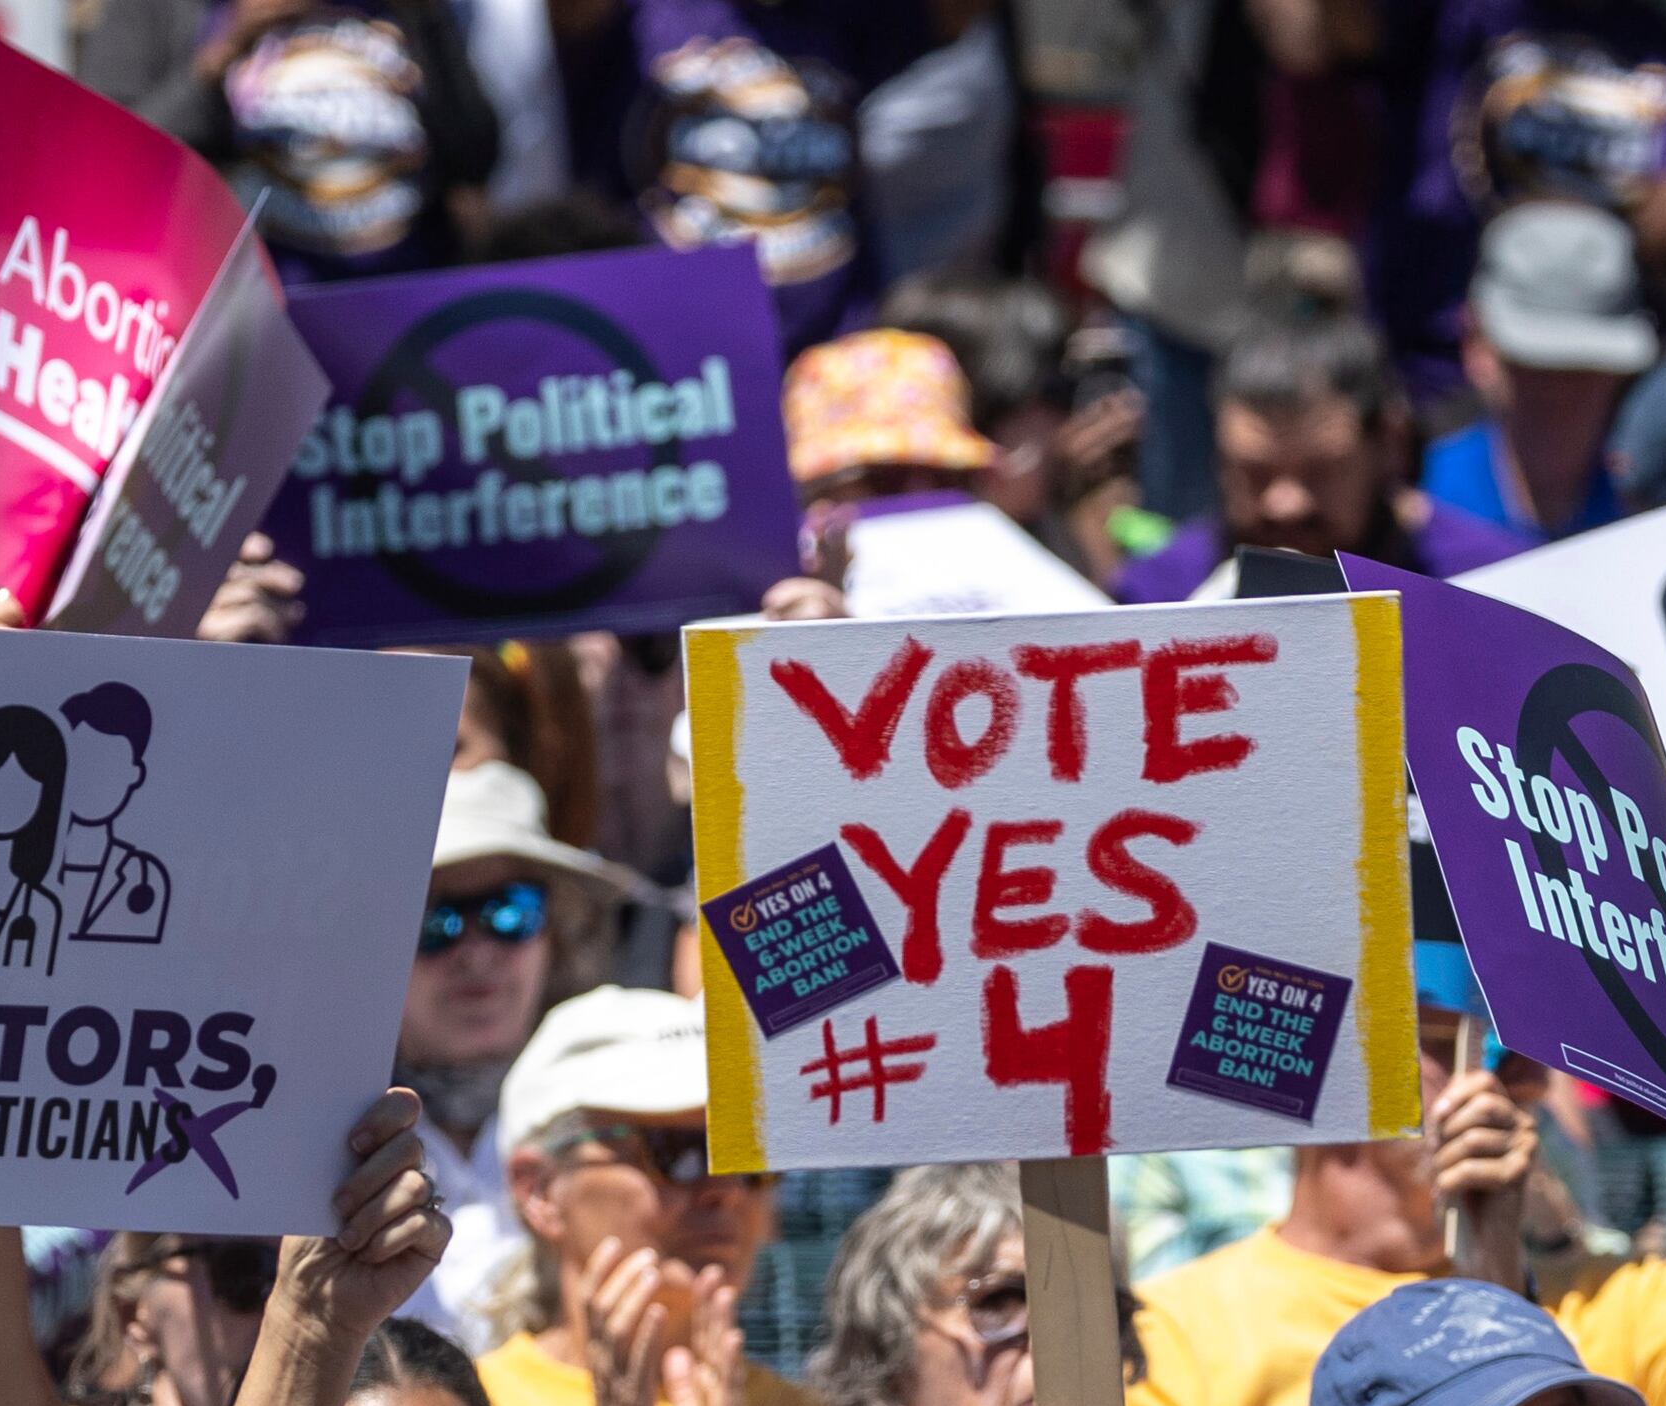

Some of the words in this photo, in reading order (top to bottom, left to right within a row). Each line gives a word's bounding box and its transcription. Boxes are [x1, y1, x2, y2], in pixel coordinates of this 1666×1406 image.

[457, 356, 735, 466] Political
[313, 460, 729, 559] Interference
[769, 633, 1279, 790] VOTE
[1456, 725, 1610, 876] Stop
[756, 892, 790, 919] YES
[789, 878, 817, 905] ON
[818, 871, 832, 891] 4
[841, 807, 1203, 985] YES
[744, 919, 793, 952] END
[794, 895, 842, 926] THE
[758, 915, 846, 968] 6-WEEK
[755, 927, 870, 994] ABORTION
[792, 960, 849, 997] BAN!
[1213, 993, 1263, 1020] END
[1269, 1007, 1314, 1035] THE
[1248, 975, 1279, 1001] YES
[1281, 985, 1307, 1009] ON
[1310, 993, 1324, 1013] 4
[799, 1011, 936, 1125] #
[982, 964, 1116, 1156] 4
[1190, 1030, 1314, 1077] ABORTION
[1212, 1015, 1306, 1053] 6-WEEK
[1218, 1058, 1277, 1088] BAN!
